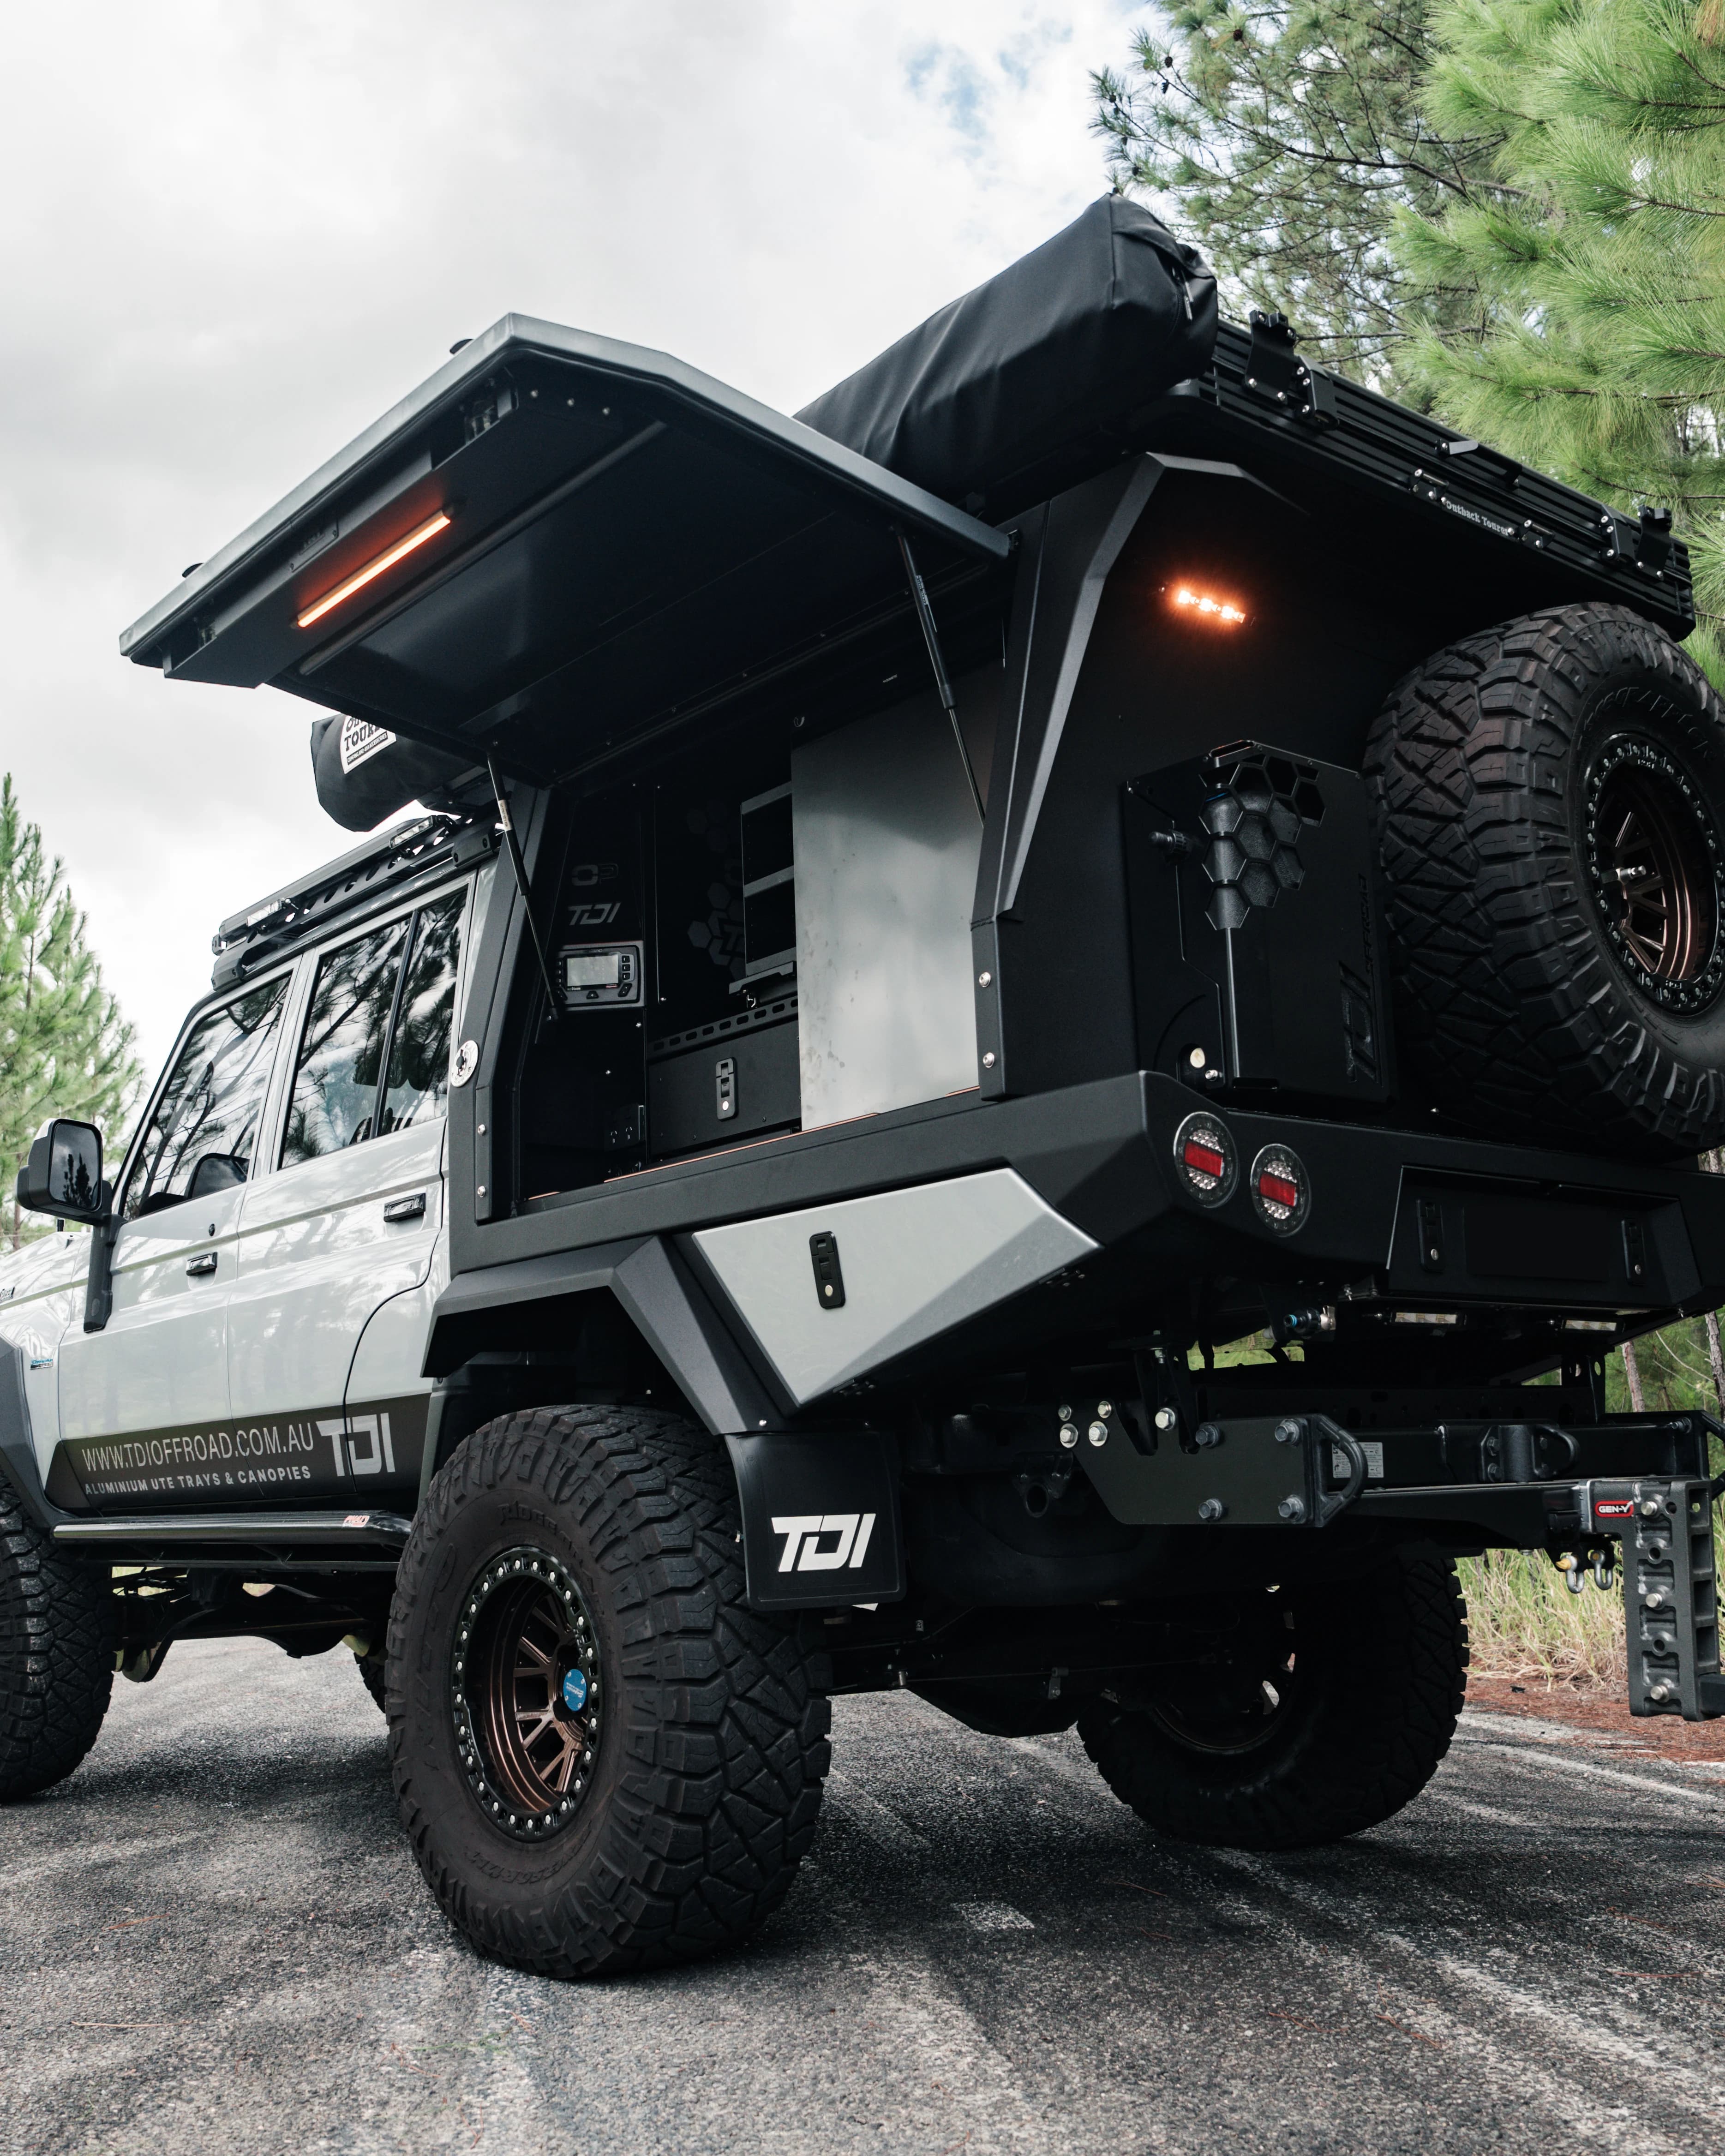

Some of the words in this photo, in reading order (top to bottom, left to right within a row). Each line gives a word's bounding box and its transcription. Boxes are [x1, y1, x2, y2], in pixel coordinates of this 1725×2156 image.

[1446, 500, 1480, 523] Outback
[1481, 515, 1509, 536] Tourer
[568, 902, 622, 926] TDI
[82, 1422, 314, 1472] WWW.TDIOFFROAD.COM.AU
[316, 1413, 395, 1477] TDI
[85, 1479, 148, 1495] ALUMINIUM
[150, 1476, 175, 1491] UTE
[177, 1473, 221, 1488] TRAYS
[225, 1472, 234, 1485] &
[238, 1466, 311, 1484] CANOPIES
[1598, 1502, 1633, 1513] GEN-Y
[771, 1513, 876, 1573] TDI
